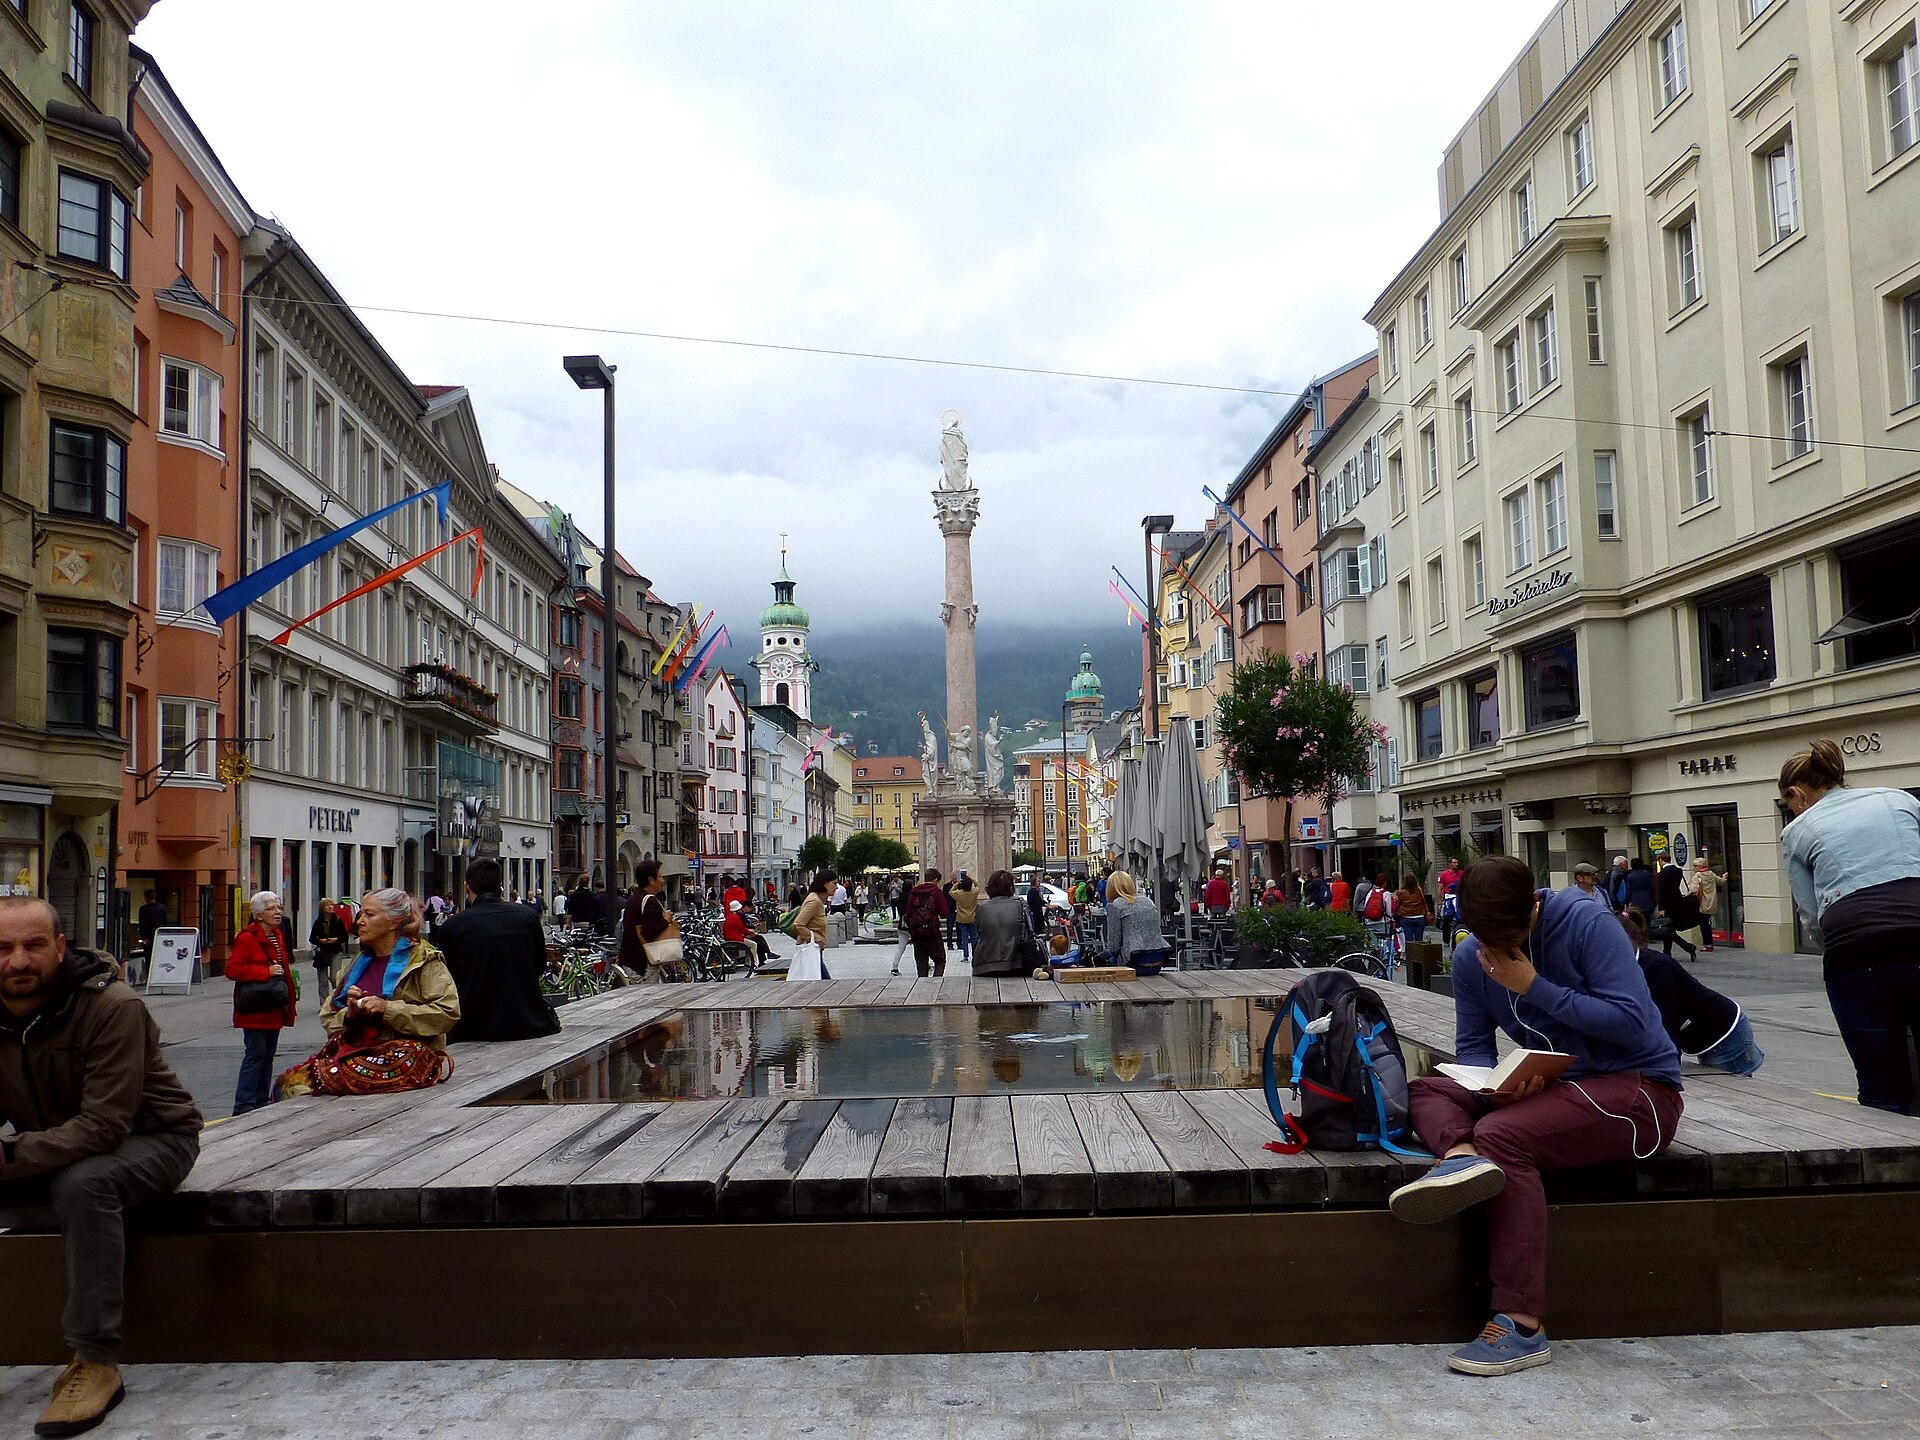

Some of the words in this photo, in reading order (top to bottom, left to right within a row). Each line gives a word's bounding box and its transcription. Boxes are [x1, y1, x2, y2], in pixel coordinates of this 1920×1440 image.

[1487, 597, 1509, 616] Das
[1509, 570, 1573, 608] Schindler
[1841, 732, 1882, 756] COS
[1678, 754, 1737, 775] TABAK
[309, 806, 352, 832] PETERA
